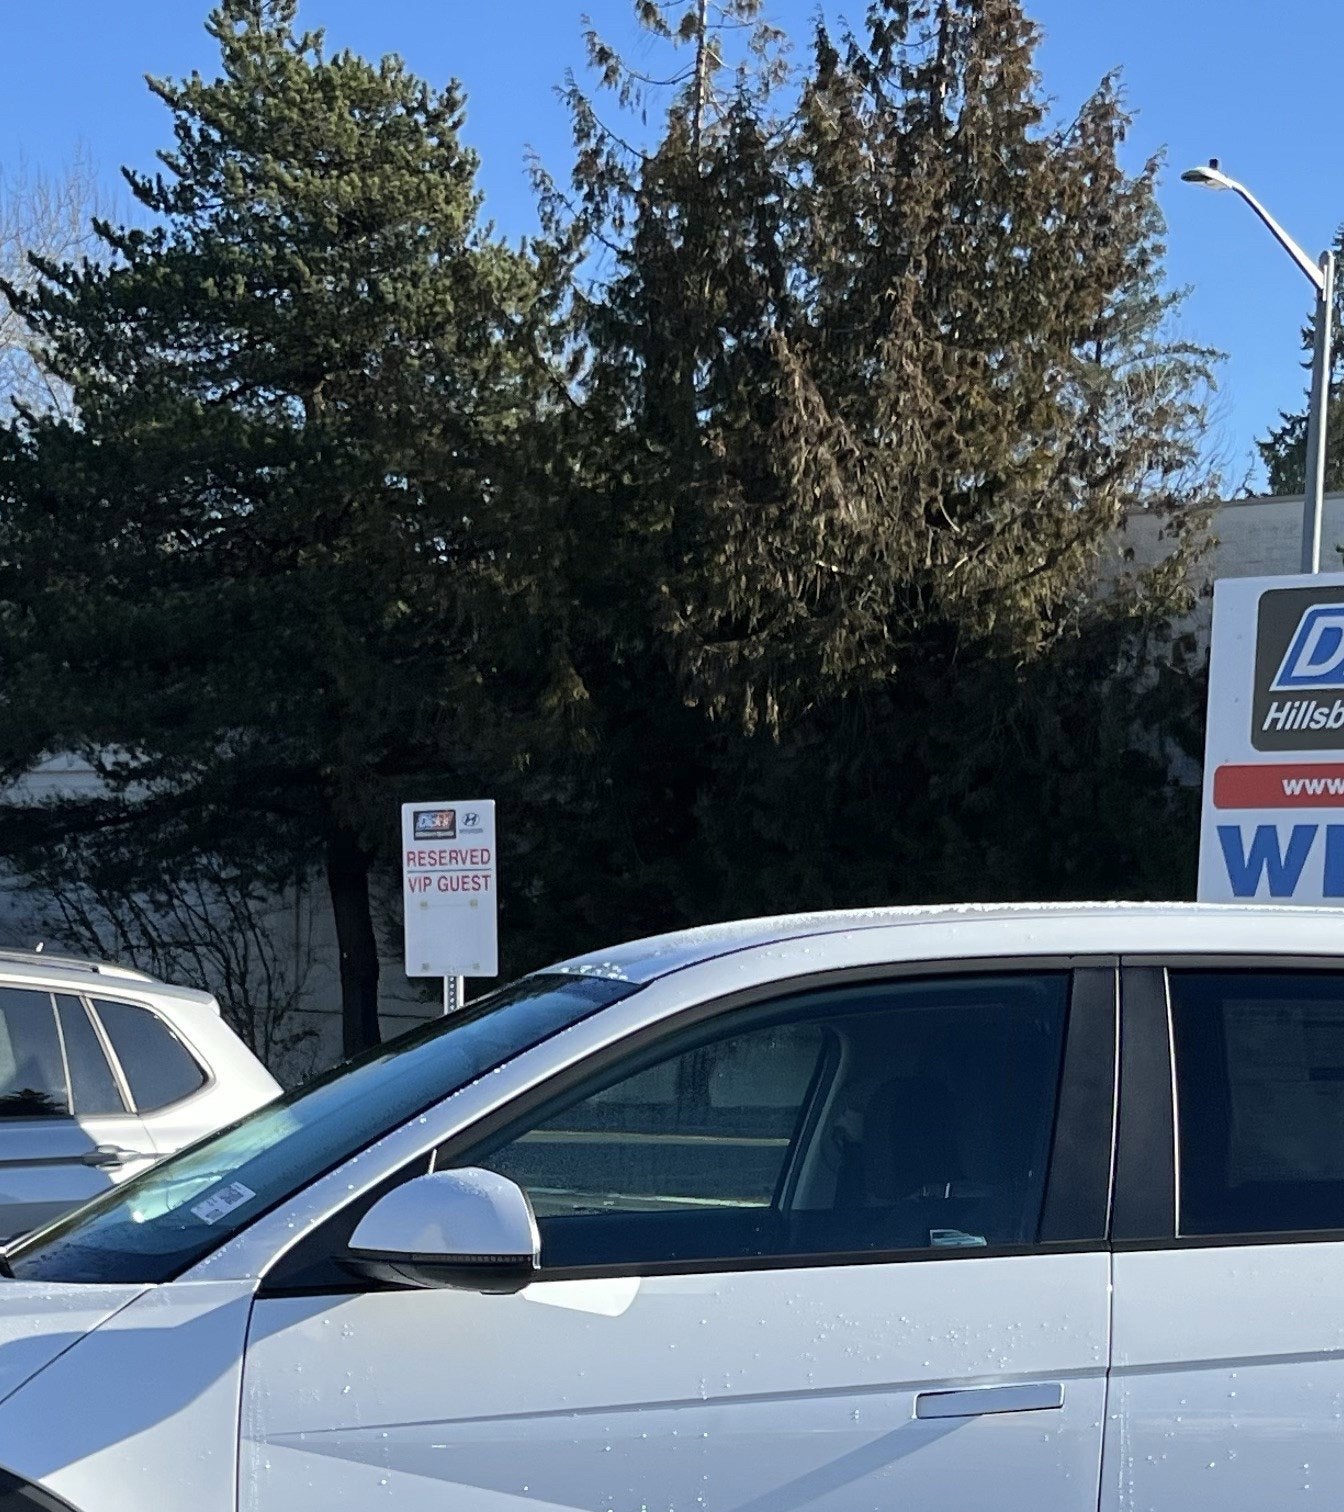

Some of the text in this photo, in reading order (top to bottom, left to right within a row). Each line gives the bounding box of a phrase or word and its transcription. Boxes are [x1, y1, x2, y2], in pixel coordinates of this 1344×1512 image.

[406, 848, 491, 868] RESERVED
[408, 874, 492, 893] VIP GUEST
